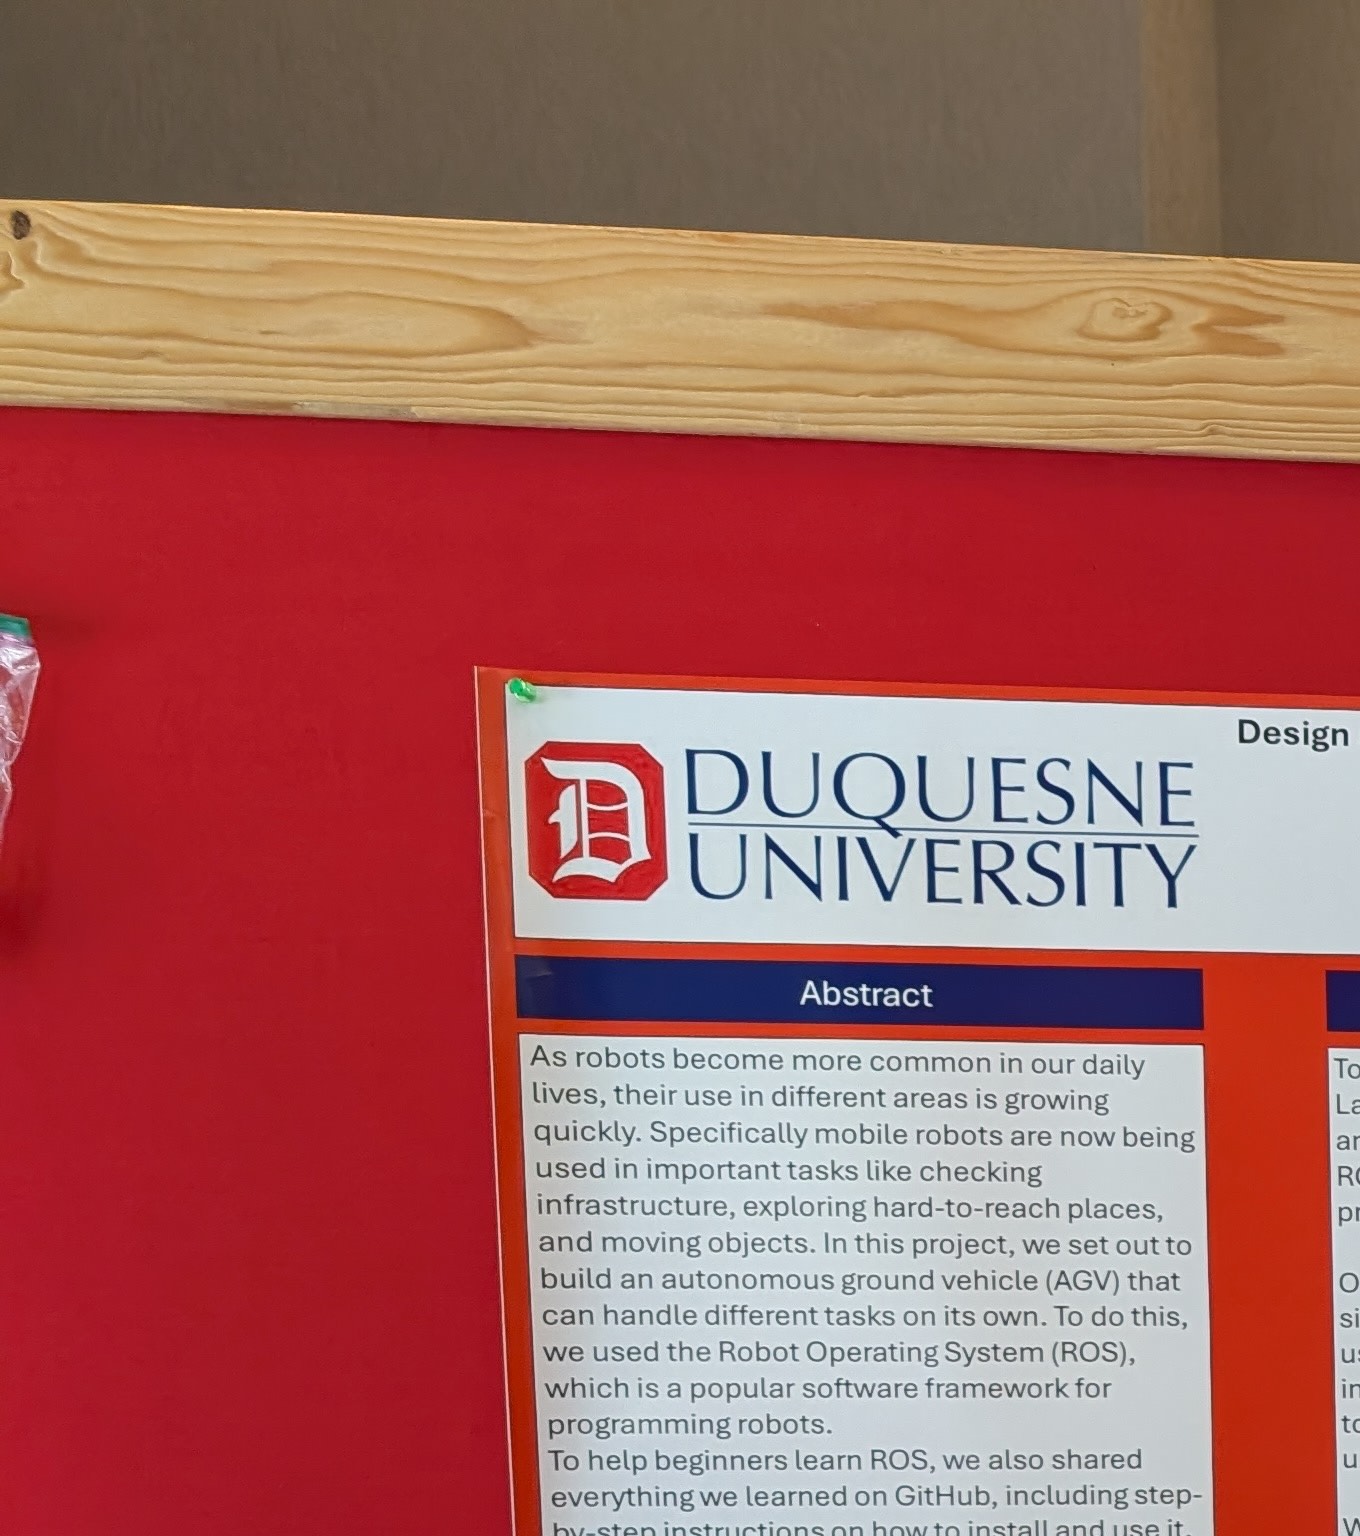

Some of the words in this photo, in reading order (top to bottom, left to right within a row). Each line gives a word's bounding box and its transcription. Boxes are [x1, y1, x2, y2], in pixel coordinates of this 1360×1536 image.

[1238, 718, 1349, 753] Design
[686, 749, 1198, 840] DUQUESNE
[689, 832, 1198, 908] UNIVERSITY
[800, 980, 932, 1007] Abstract
[529, 1044, 568, 1068] As
[575, 1046, 666, 1069] robots
[673, 1047, 784, 1071] become
[792, 1054, 862, 1072] more
[869, 1055, 991, 1074] common
[999, 1051, 1023, 1074] in
[1031, 1057, 1076, 1075] our
[1082, 1053, 1146, 1081] daily
[536, 1192, 736, 1220] infrastructure,
[743, 1195, 868, 1223] exploring
[873, 1195, 1061, 1219] hard-to-reach
[1068, 1197, 1163, 1224] places,
[542, 1345, 585, 1363] we
[592, 1340, 659, 1363] used
[666, 1340, 712, 1363] the
[718, 1340, 800, 1363] Robot
[806, 1340, 940, 1368] Operating
[944, 1340, 1044, 1368] System
[1051, 1340, 1136, 1368] (ROS),
